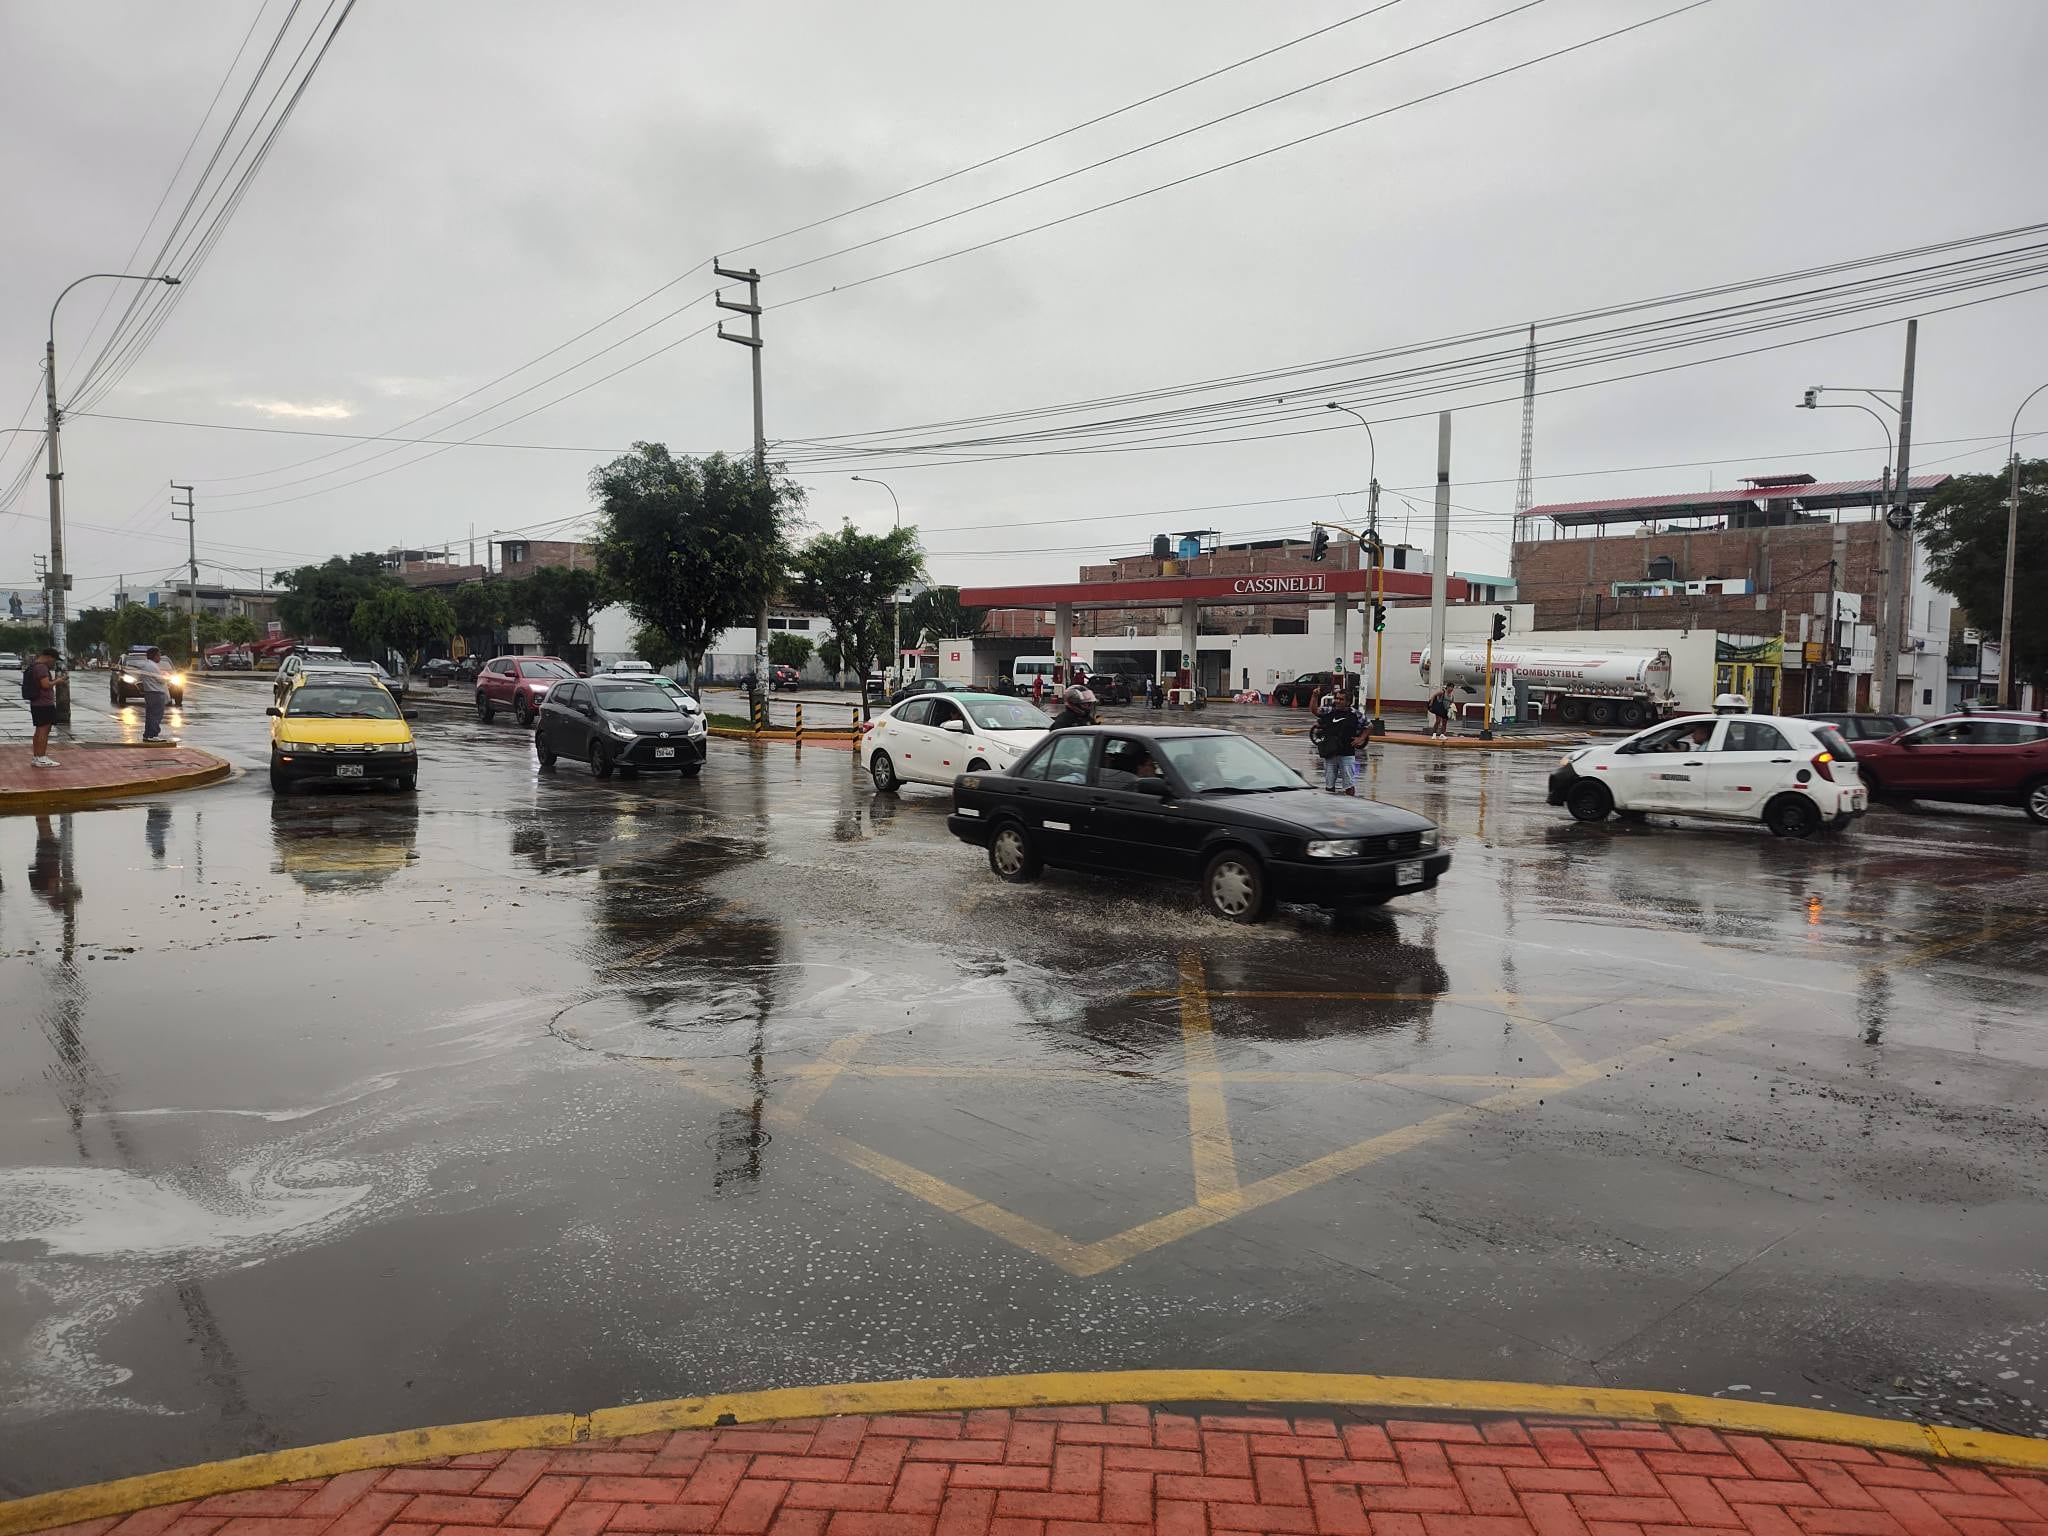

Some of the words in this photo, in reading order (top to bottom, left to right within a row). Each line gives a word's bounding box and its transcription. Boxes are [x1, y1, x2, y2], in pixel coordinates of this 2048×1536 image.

[1234, 576, 1323, 592] CASSINELLI
[1459, 654, 1521, 662] CASSNELLI
[1516, 668, 1584, 679] COMBUSTIBLE
